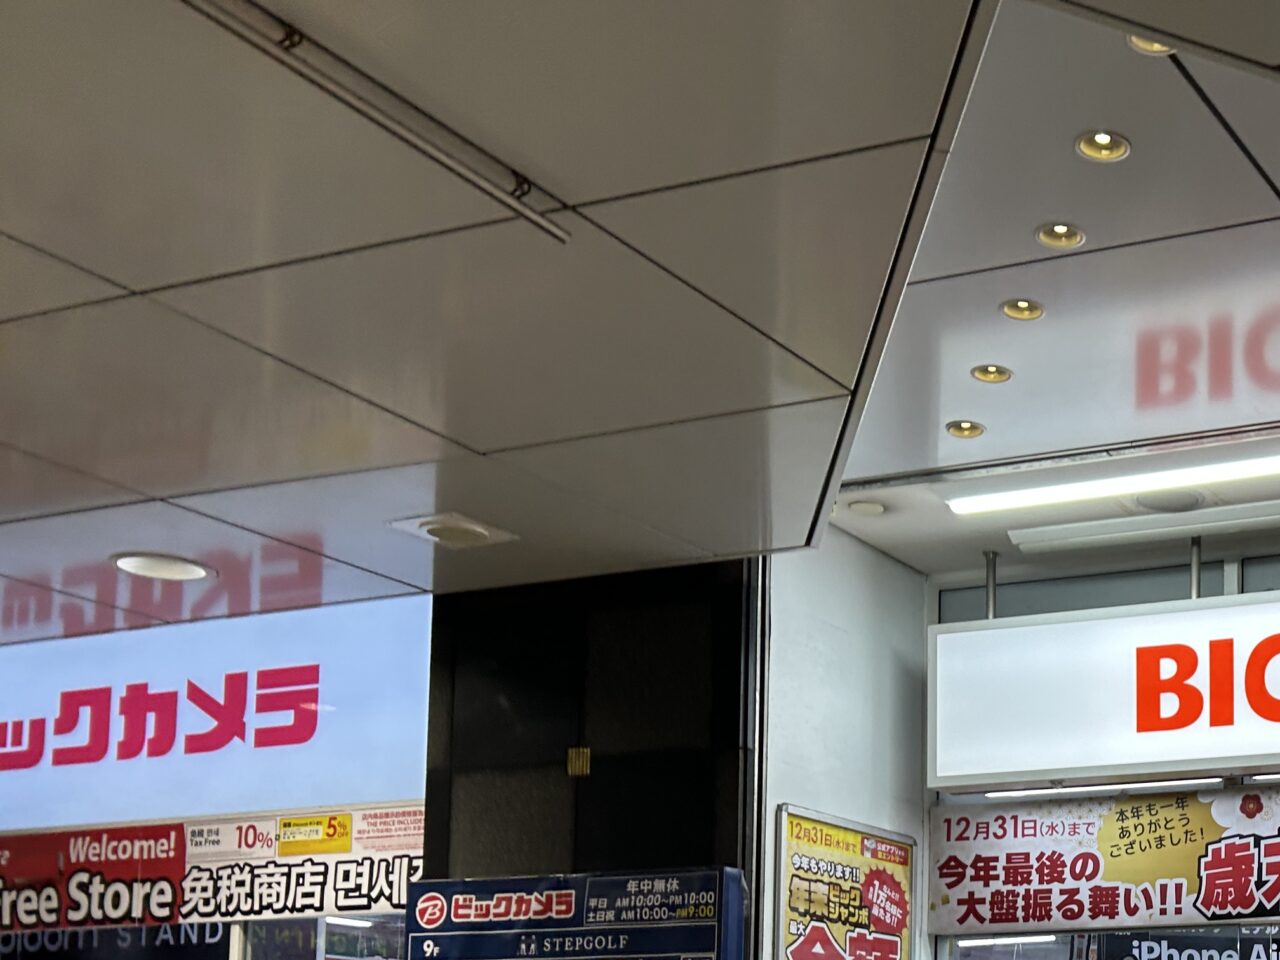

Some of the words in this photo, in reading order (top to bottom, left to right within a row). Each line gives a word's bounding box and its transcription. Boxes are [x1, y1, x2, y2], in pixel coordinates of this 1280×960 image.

[1115, 797, 1190, 823] 本年も一年
[235, 824, 274, 850] 10%
[325, 815, 348, 839] 5%
[789, 820, 858, 854] 12月31日(水)まで
[943, 815, 1096, 842] 12月31日(水)まで
[1118, 812, 1192, 840] ありがとう
[69, 831, 176, 864] Welcome!
[189, 838, 203, 847] Tax
[203, 836, 222, 847] Free
[1109, 828, 1206, 858] ございました!
[791, 852, 861, 884] 今年もやります!!
[937, 851, 1101, 889] 今年最後の
[0, 886, 58, 925] ree
[67, 871, 173, 922] Store
[180, 861, 327, 917] 免税商店
[626, 878, 680, 894] 年中無休
[829, 883, 862, 908] ビック
[450, 890, 576, 923] ビックカメラ
[588, 897, 609, 909] 平日
[828, 902, 870, 926] ジャンボ
[956, 882, 1184, 925] 大盤振る舞い!!
[116, 922, 224, 948] STAND
[422, 940, 440, 957] 9F
[543, 934, 630, 952] STEPGOLF
